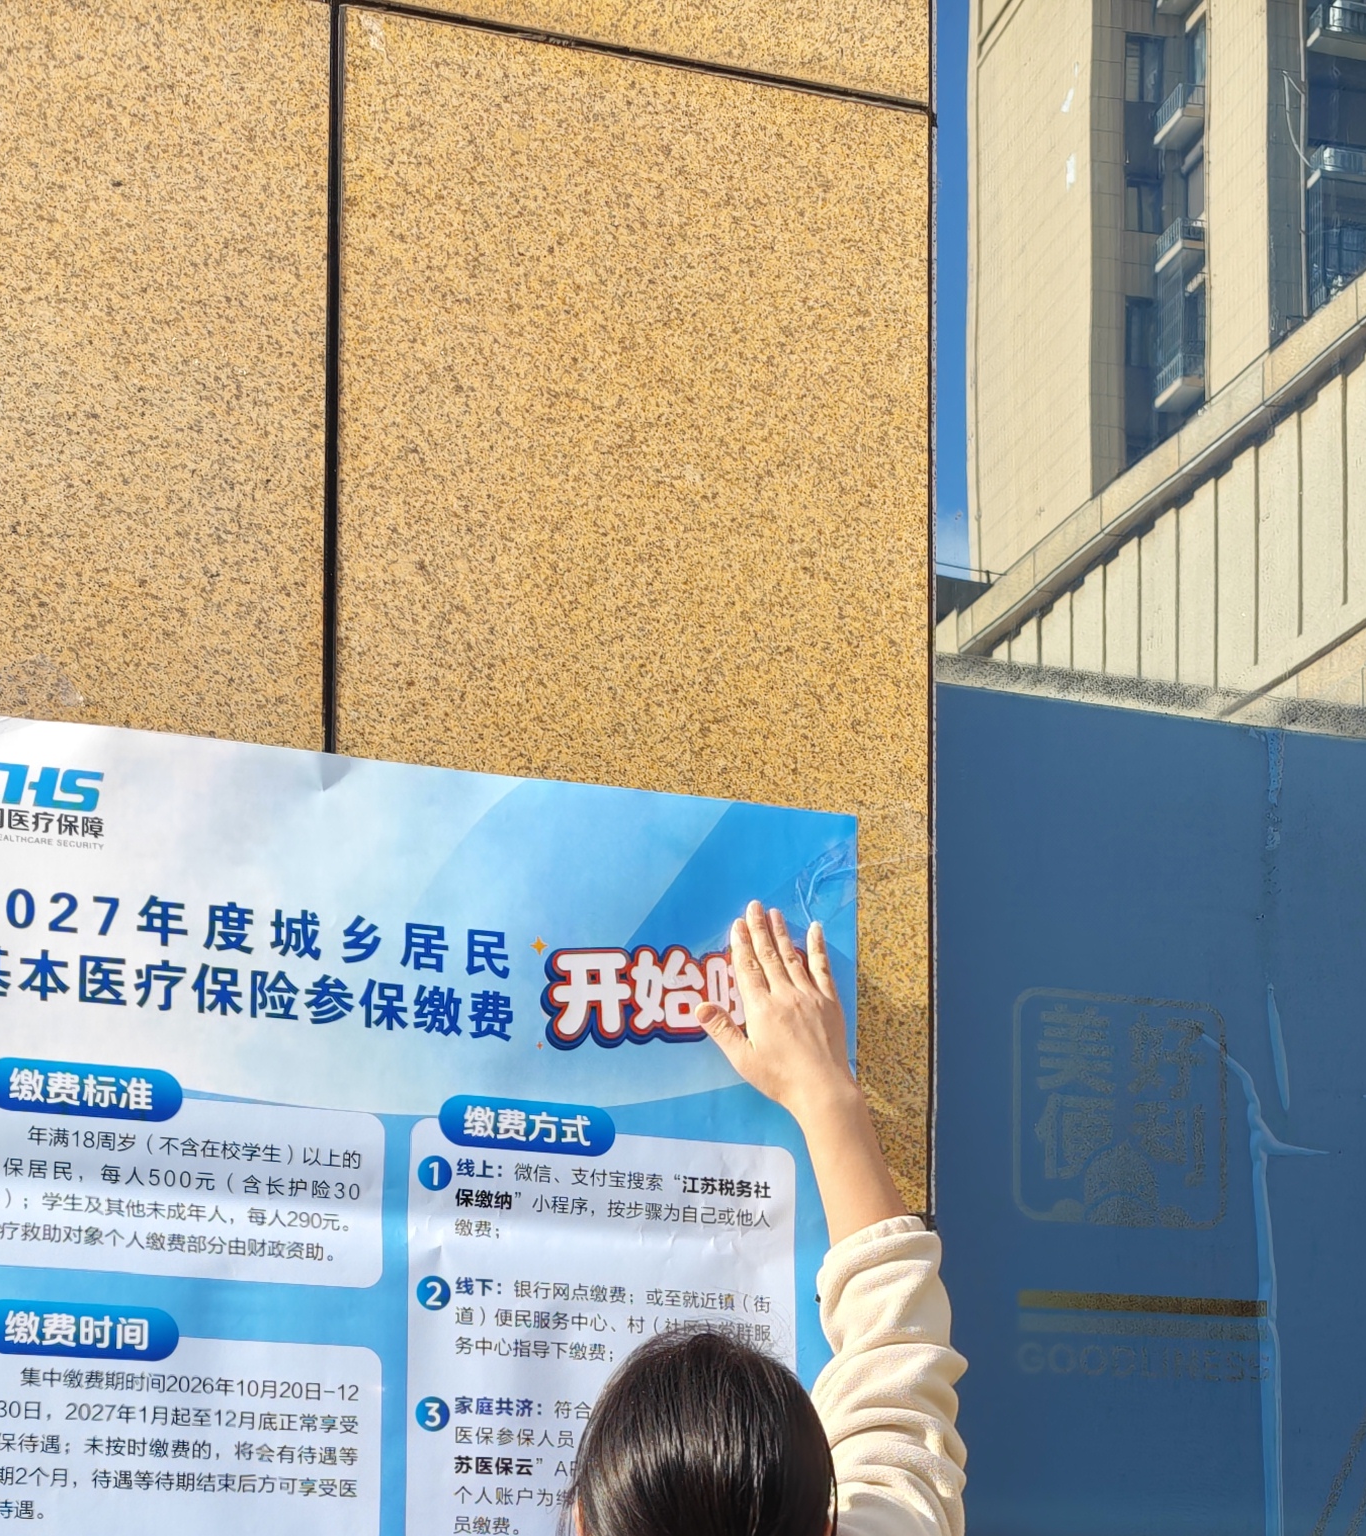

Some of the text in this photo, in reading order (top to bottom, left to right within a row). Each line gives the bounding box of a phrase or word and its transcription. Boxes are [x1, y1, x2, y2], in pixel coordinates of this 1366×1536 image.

[56, 839, 104, 850] SECURITY
[9, 1067, 154, 1112] 缴费标准
[463, 1105, 592, 1147] 缴费方式
[27, 1125, 362, 1170] 年满18周岁（不含在校学生）以上的
[454, 1219, 501, 1240] 缴费；
[5, 1310, 150, 1351] 缴费时间
[454, 1336, 614, 1364] 务中心指导下缴费；
[455, 1426, 575, 1448] 医保参保人员
[453, 1516, 520, 1536] 员缴费。
